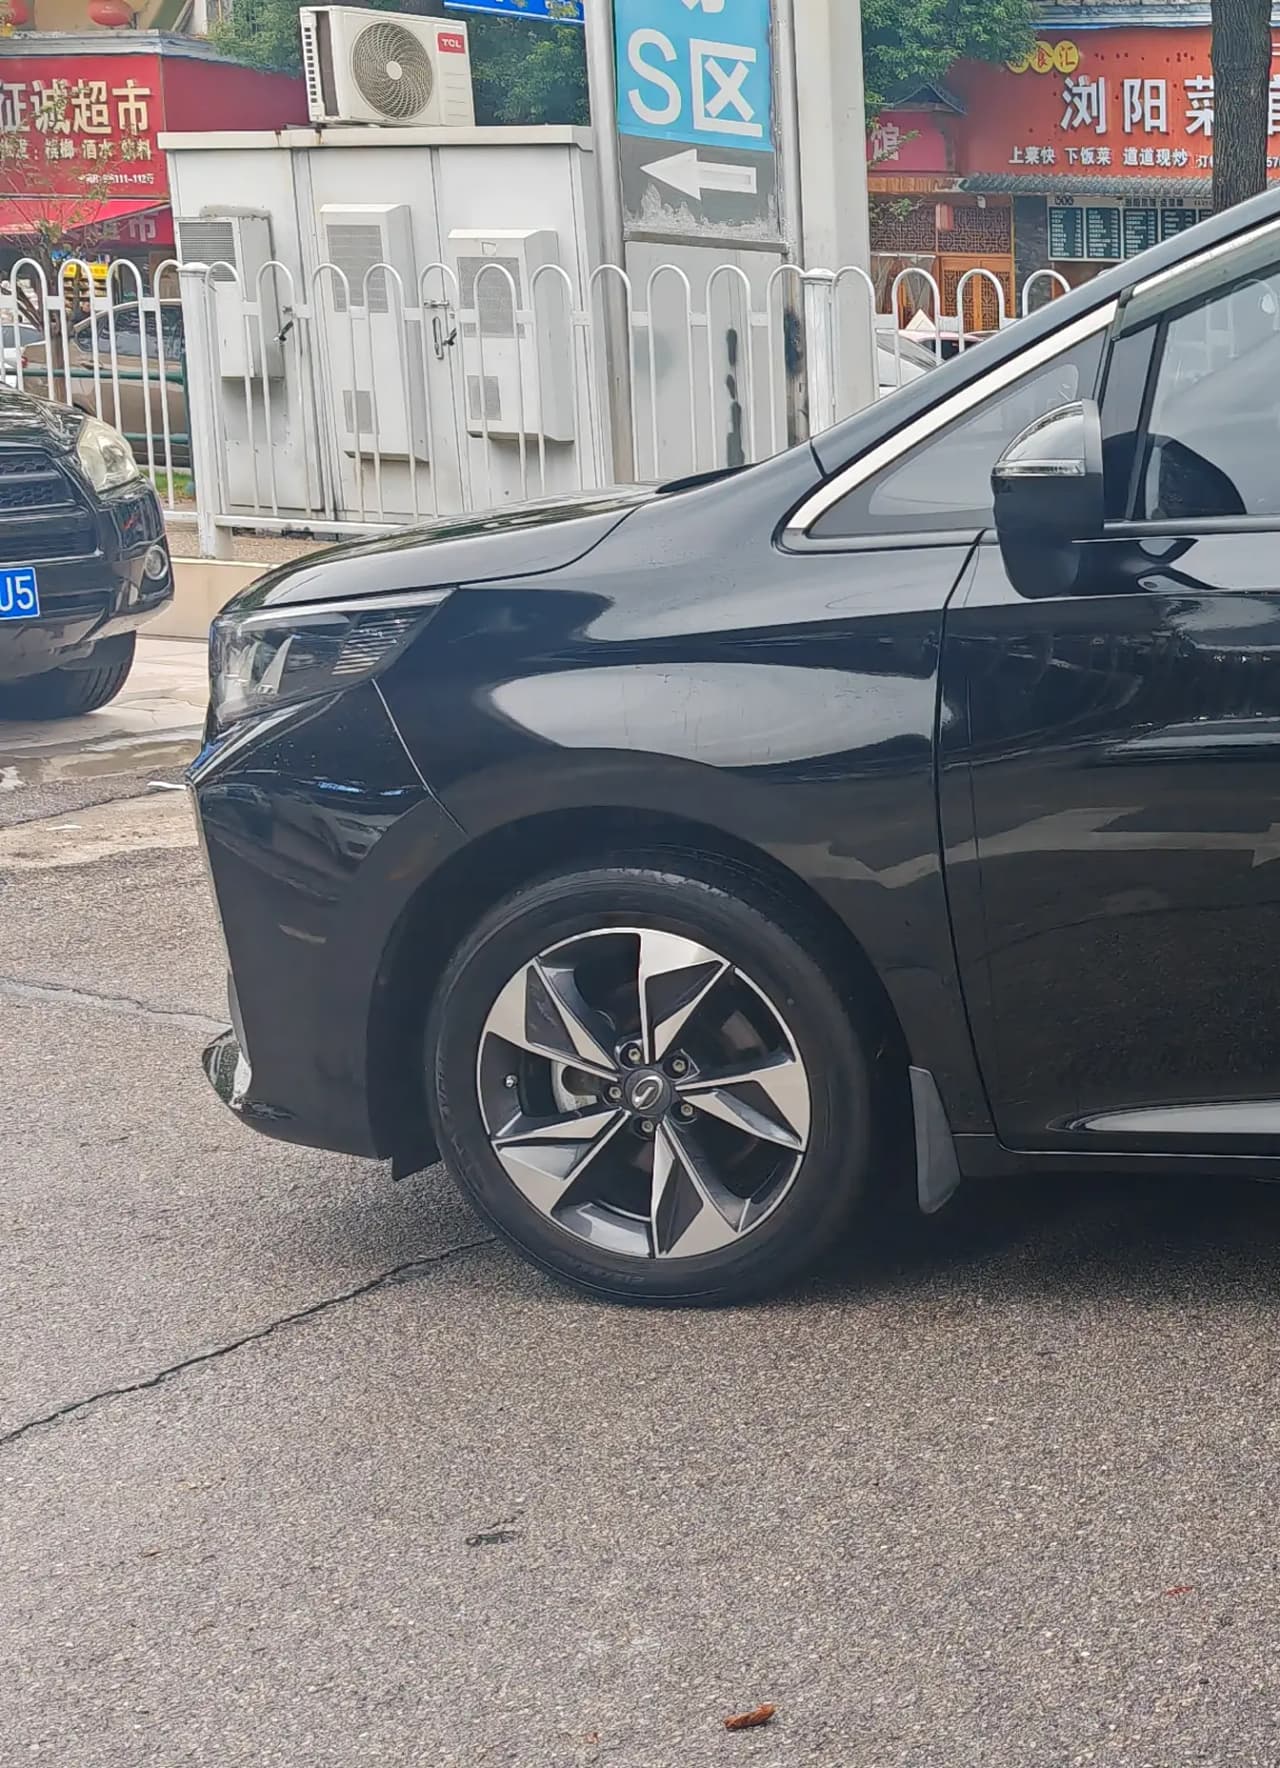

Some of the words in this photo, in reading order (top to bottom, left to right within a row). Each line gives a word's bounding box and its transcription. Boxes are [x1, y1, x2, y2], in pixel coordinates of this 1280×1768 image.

[441, 38, 462, 48] TCL
[627, 27, 764, 138] S区
[82, 139, 113, 160] 酒水
[1009, 146, 1056, 165] 上菜快
[1066, 147, 1112, 166] 下饭菜
[1123, 147, 1190, 167] 道道现炒
